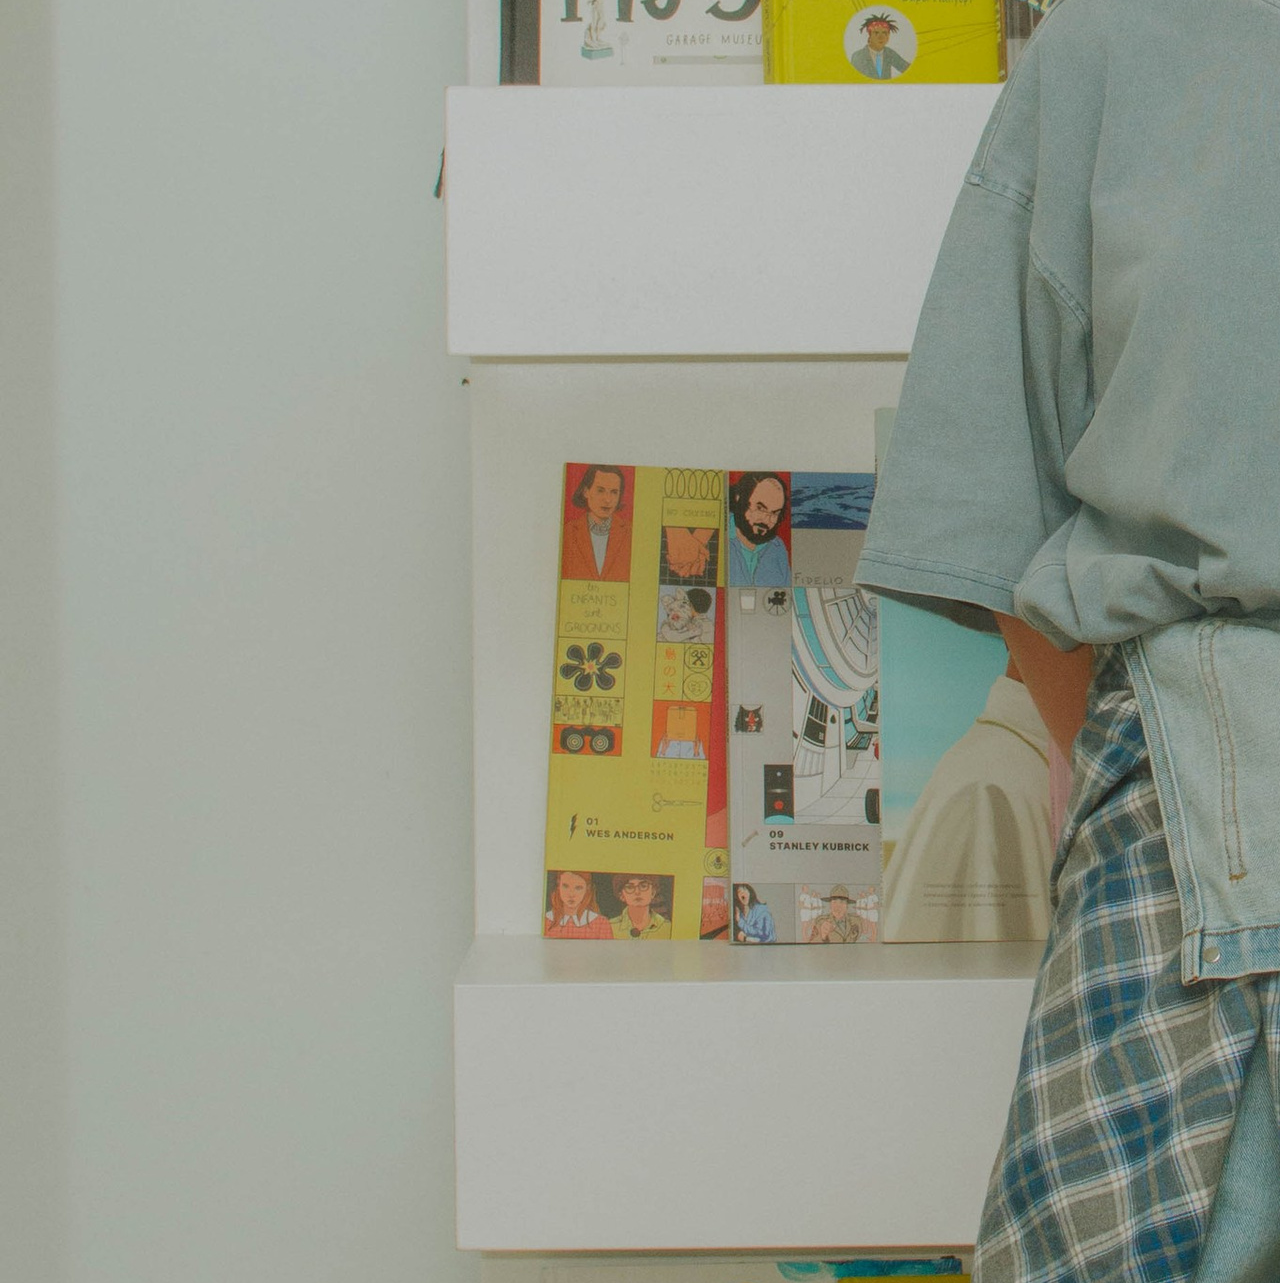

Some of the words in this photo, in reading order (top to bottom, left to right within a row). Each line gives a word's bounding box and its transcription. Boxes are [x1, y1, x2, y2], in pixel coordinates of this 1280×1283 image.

[666, 33, 713, 46] GARAGE
[794, 572, 844, 585] FIDELIO
[586, 817, 599, 826] 01
[586, 829, 611, 838] WES
[613, 830, 674, 841] ANDERSON
[769, 830, 784, 838] 09
[769, 842, 819, 850] STANLEY
[822, 842, 870, 851] KUBRICK
